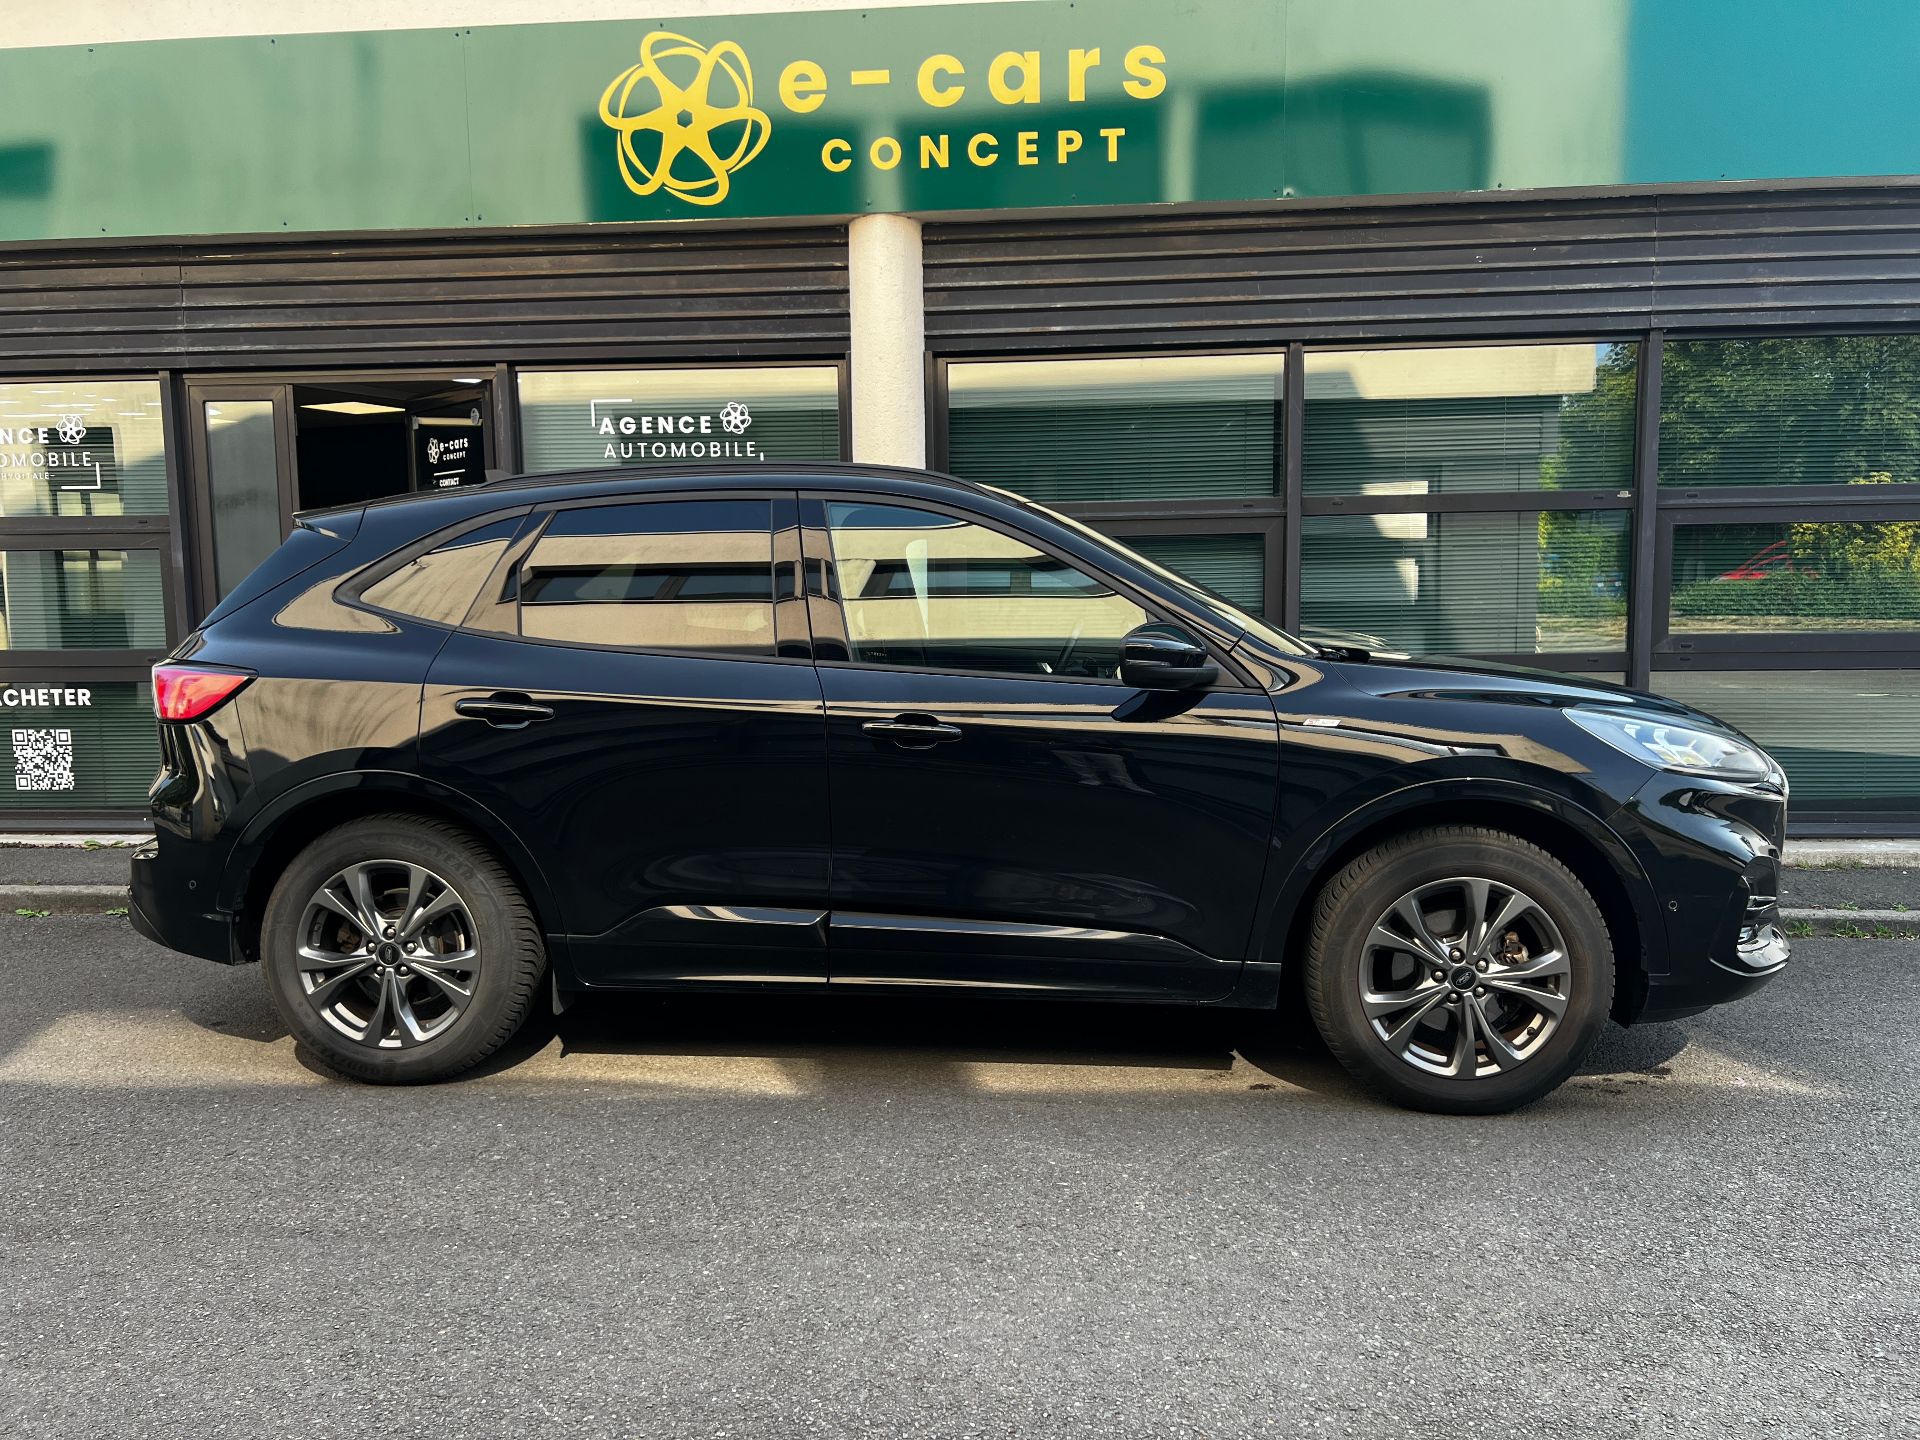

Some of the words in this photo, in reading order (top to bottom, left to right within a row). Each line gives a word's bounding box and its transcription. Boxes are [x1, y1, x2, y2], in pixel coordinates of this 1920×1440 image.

[779, 45, 1167, 113] e-cars
[821, 128, 1126, 172] CONCEPT
[599, 415, 712, 435] AGENCE
[439, 437, 468, 452] e-cars
[604, 441, 756, 459] AUTOMOBILE
[442, 451, 466, 461] CONCEPT
[439, 477, 460, 487] CONTACT
[0, 688, 92, 706] CHETER
